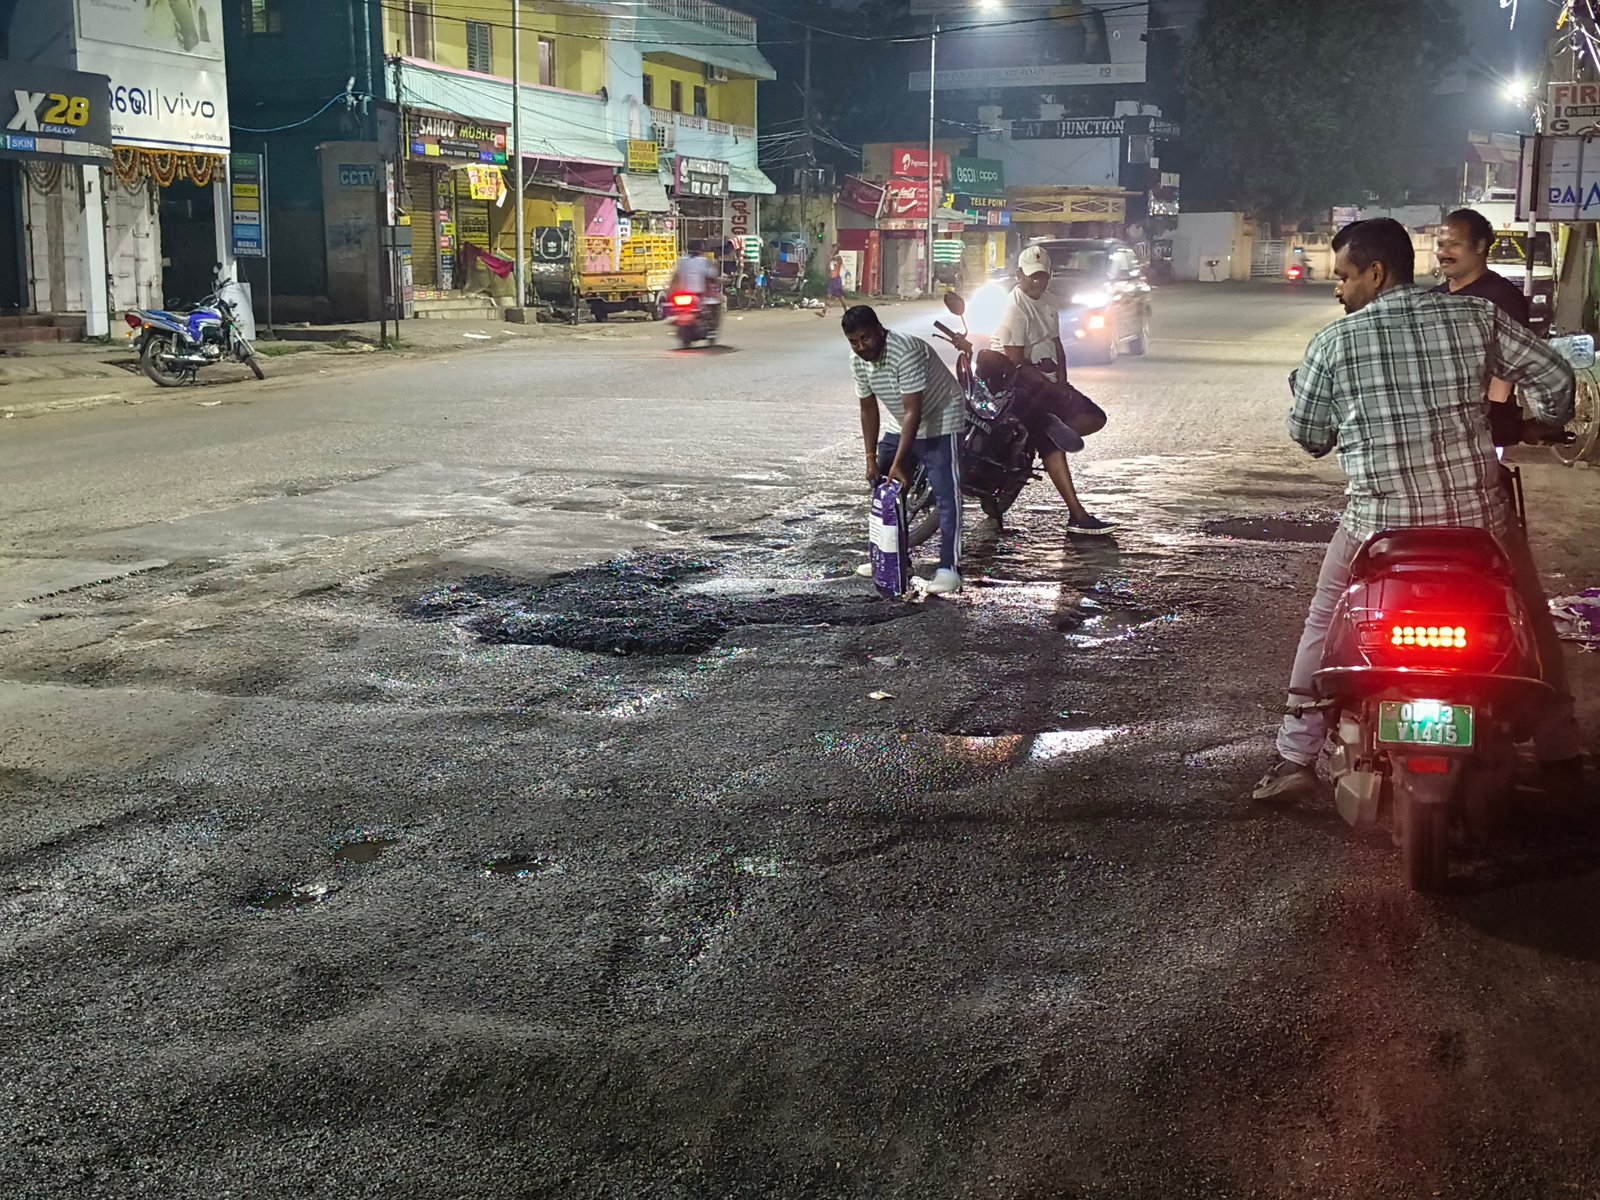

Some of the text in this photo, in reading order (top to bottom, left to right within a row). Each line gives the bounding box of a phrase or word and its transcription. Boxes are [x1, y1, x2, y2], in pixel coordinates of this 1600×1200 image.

[1555, 86, 1600, 104] FIR
[6, 89, 89, 132] X28
[163, 92, 215, 118] vivo
[44, 126, 77, 135] SALON
[419, 117, 497, 141] SAHOO MOBILE
[1060, 120, 1126, 138] JUNCTION
[11, 139, 34, 149] SKIN
[340, 169, 376, 185] CCTV
[979, 170, 998, 182] oppo
[970, 197, 1008, 208] TELE POINT
